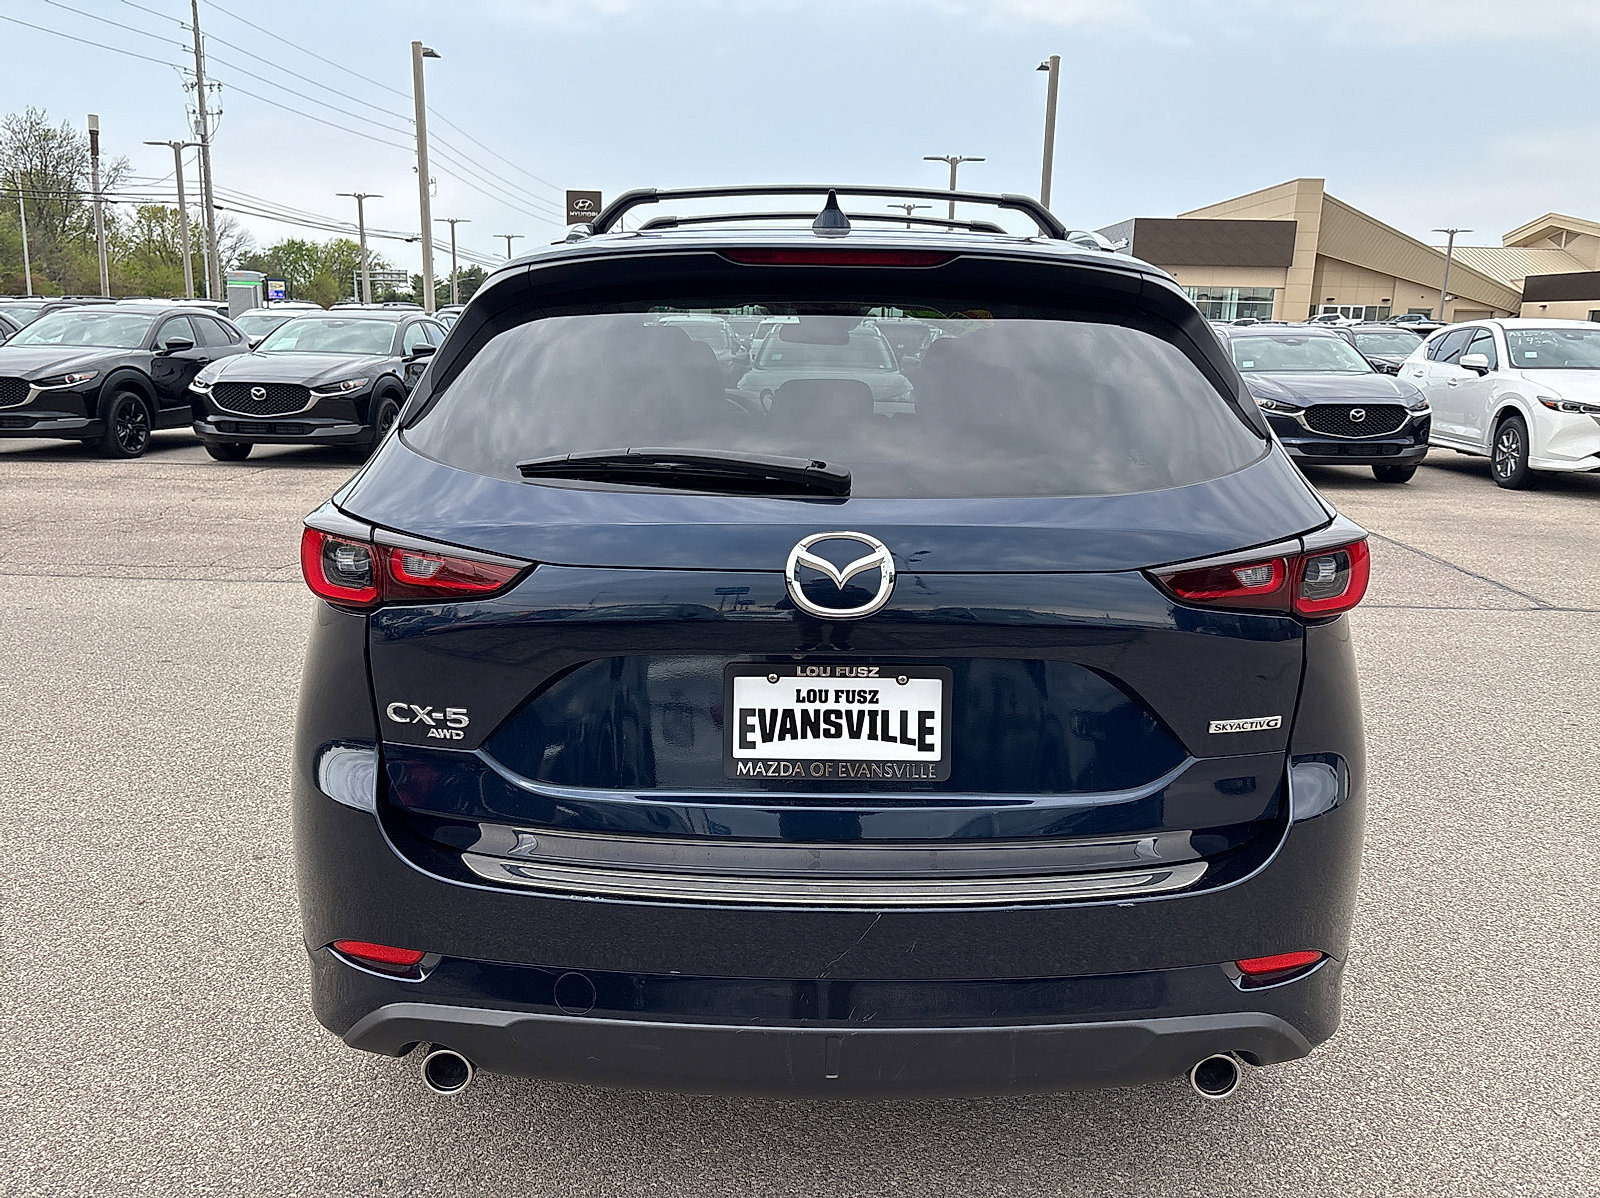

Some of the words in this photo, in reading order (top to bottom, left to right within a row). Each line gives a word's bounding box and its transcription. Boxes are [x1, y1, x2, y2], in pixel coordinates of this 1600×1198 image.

[797, 666, 831, 677] LOU
[836, 666, 880, 678] FUSZ
[795, 689, 829, 704] LOU
[834, 690, 879, 704] FUSZ
[386, 702, 470, 728] CX-5
[427, 728, 464, 740] AWD
[739, 708, 935, 752] EVANSVILLE
[736, 762, 806, 777] MAZDA
[809, 763, 834, 777] OF
[838, 763, 937, 778] EVANSVILLE
